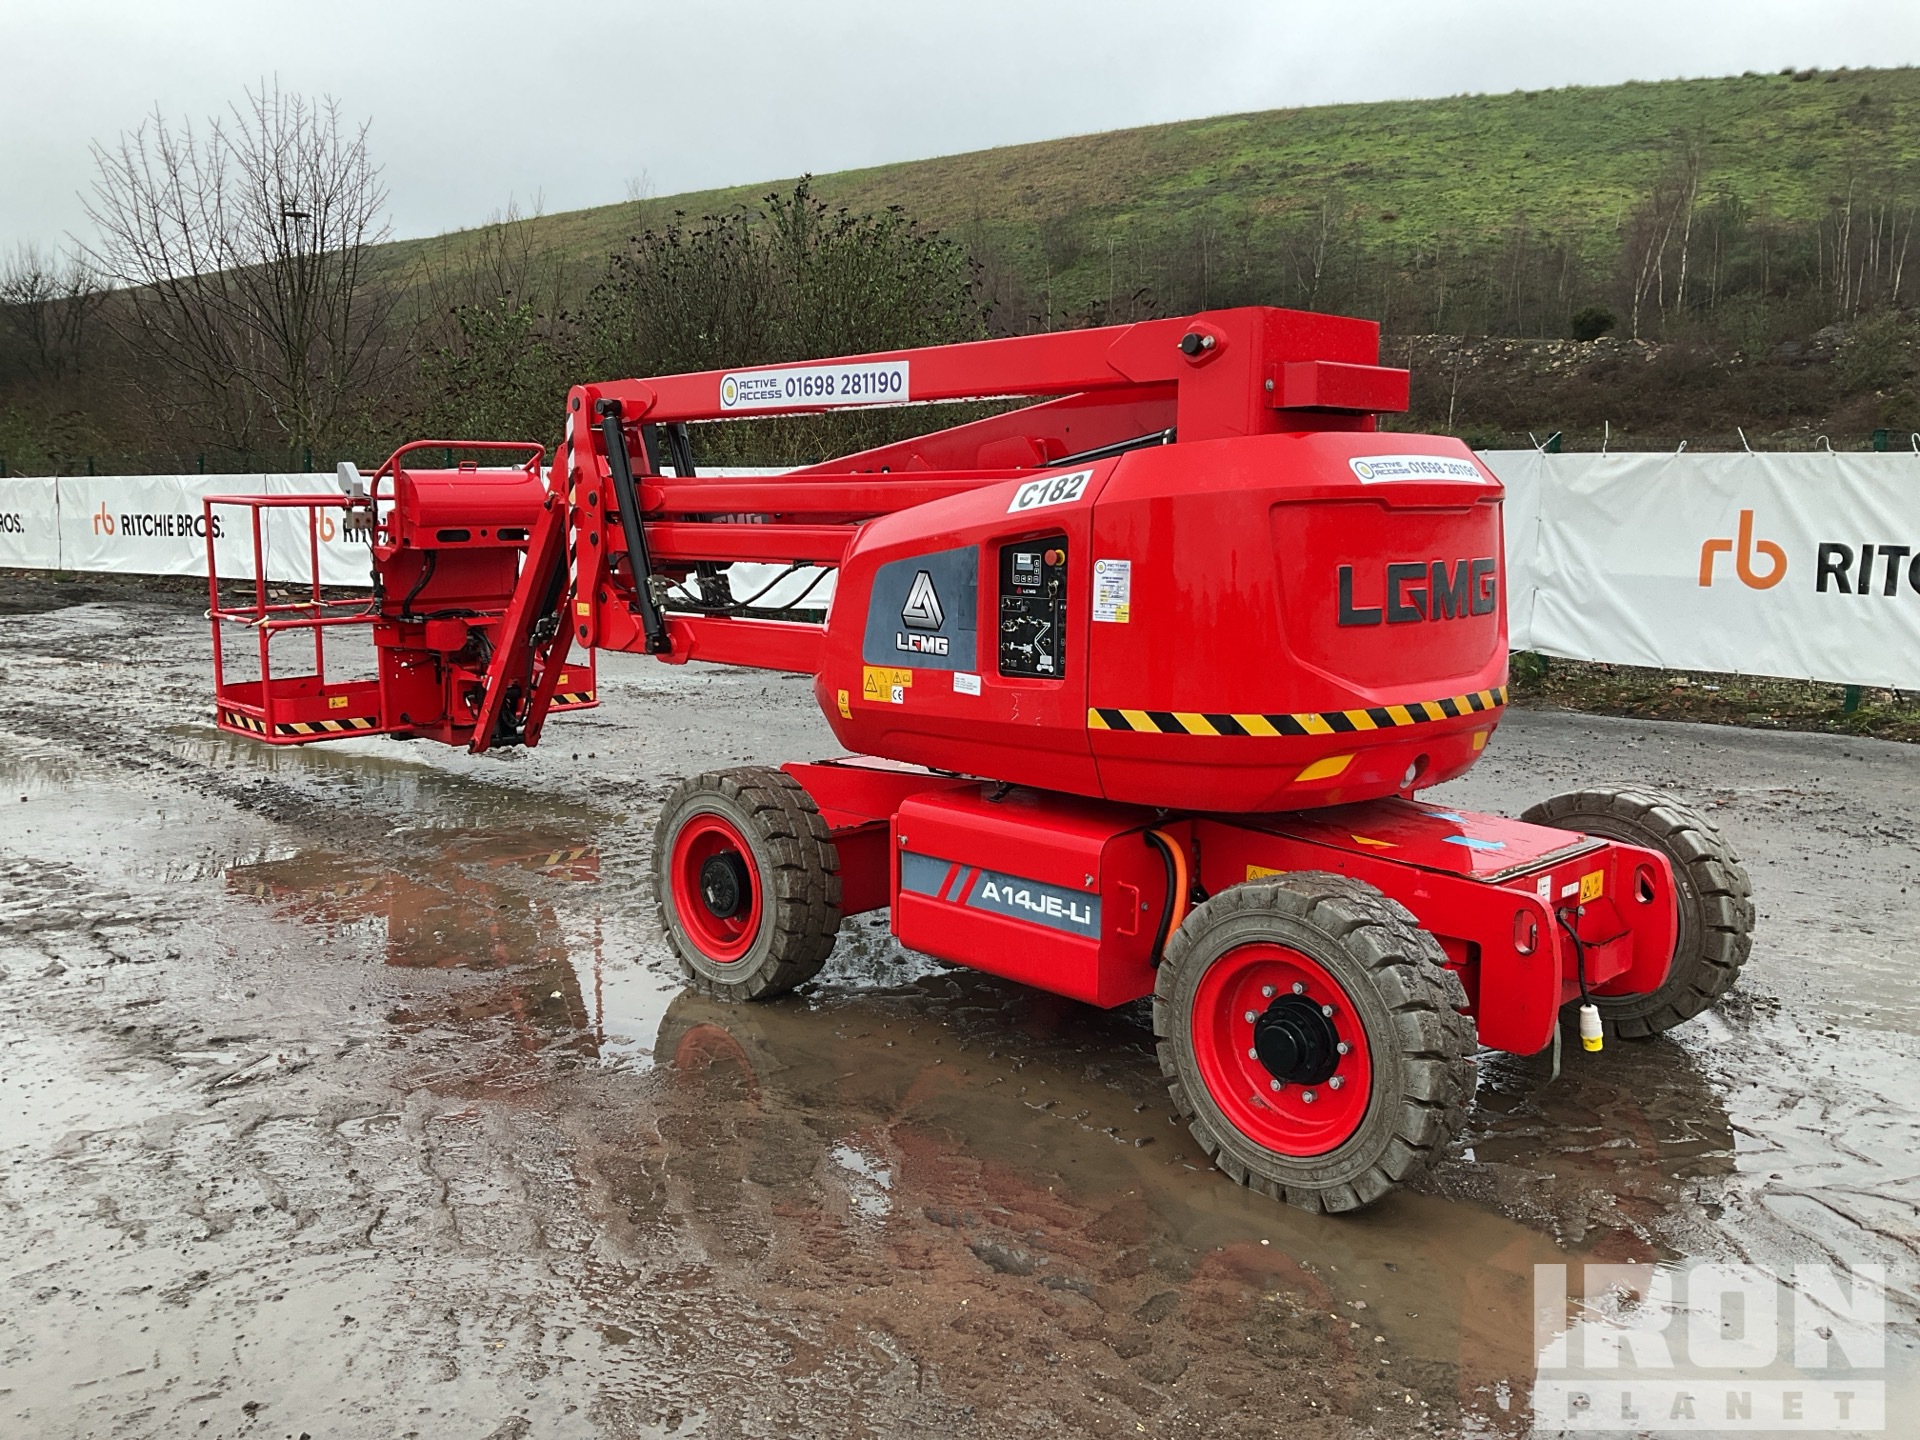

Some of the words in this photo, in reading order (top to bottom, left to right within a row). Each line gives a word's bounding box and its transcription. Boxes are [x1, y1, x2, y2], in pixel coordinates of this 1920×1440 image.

[739, 378, 777, 390] ACTIVE
[739, 390, 782, 401] ACCESS
[785, 375, 835, 398] 01698
[840, 370, 902, 395] 281190
[1408, 461, 1445, 474] 01698
[1018, 473, 1084, 508] C182
[121, 514, 174, 537] RITCHIE
[1699, 509, 1788, 590] rb
[1337, 557, 1496, 626] LGMG
[896, 632, 949, 655] LGMG
[981, 881, 1091, 925] A14JE-Li
